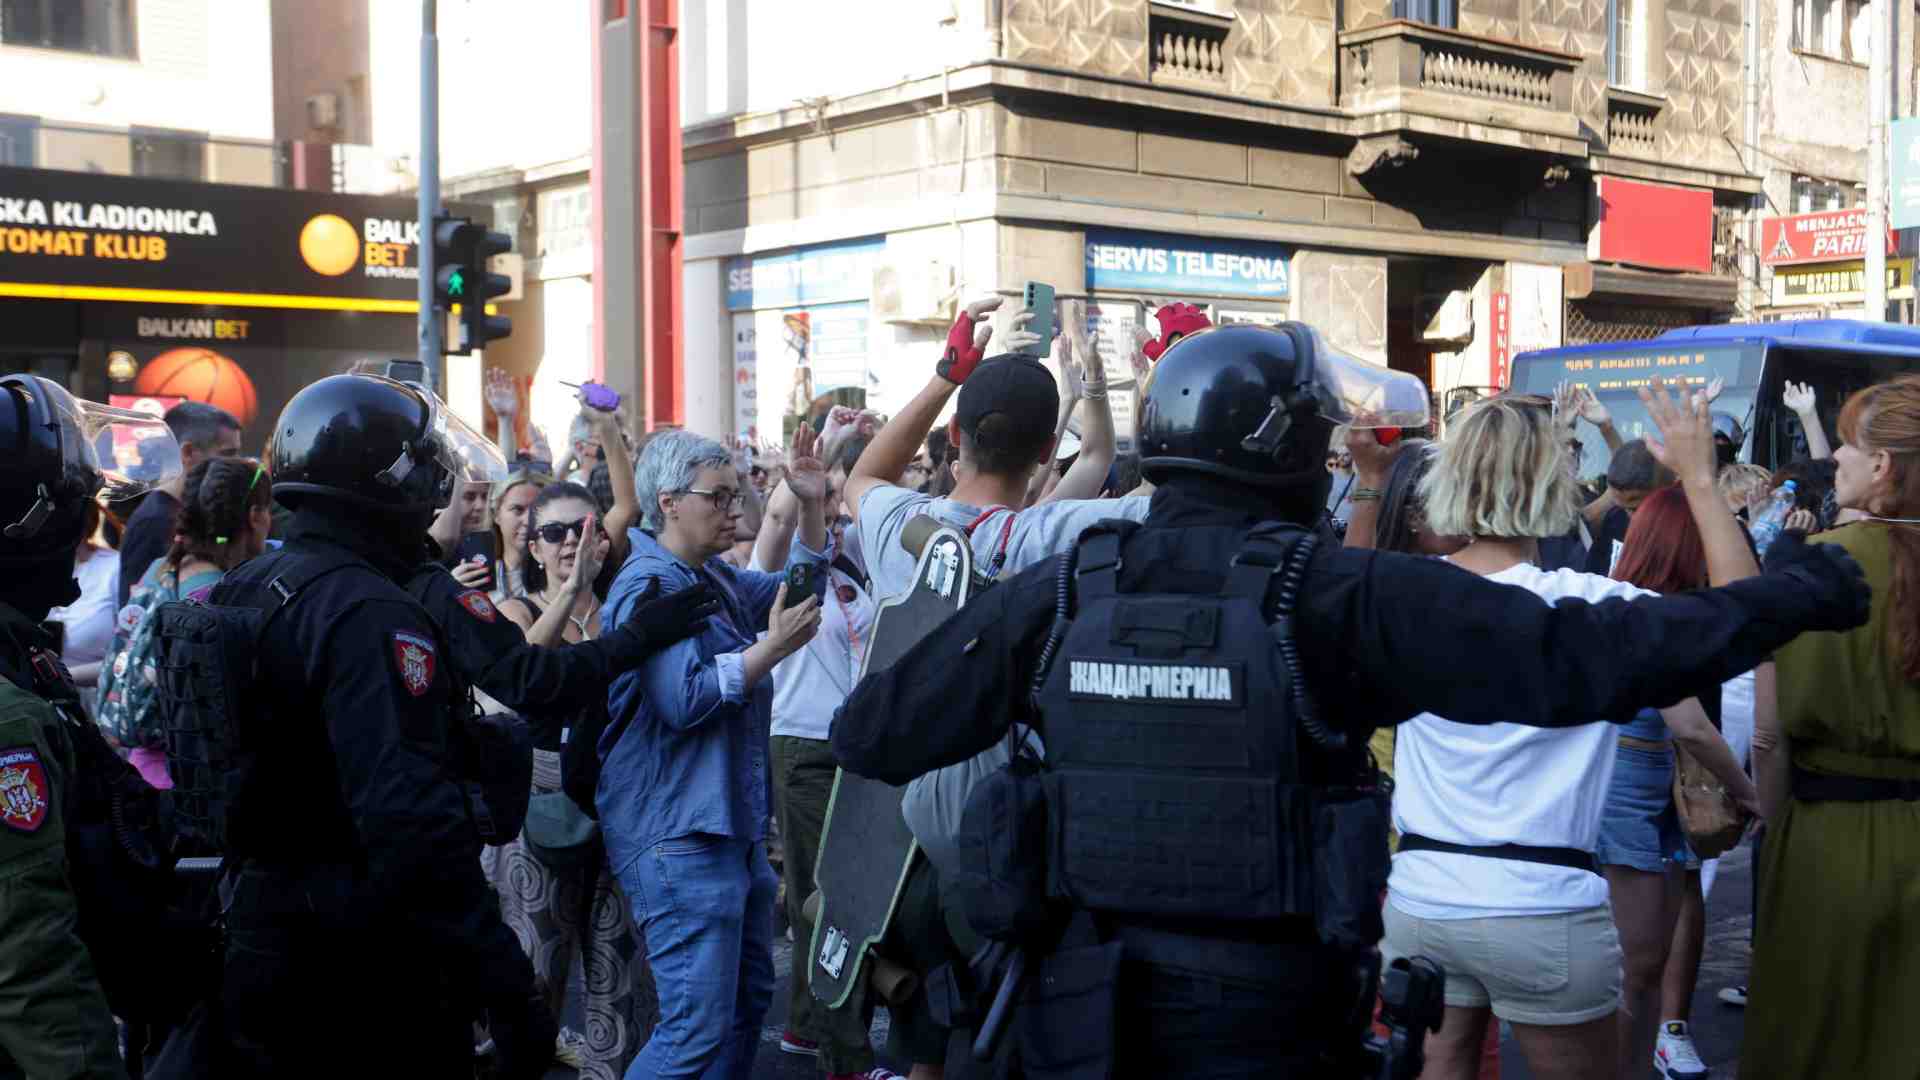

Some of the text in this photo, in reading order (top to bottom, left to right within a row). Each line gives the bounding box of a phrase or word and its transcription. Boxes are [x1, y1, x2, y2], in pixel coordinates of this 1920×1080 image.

[52, 200, 218, 236] KLADIONICA
[365, 217, 420, 245] BALK
[94, 232, 167, 261] KLUB
[365, 242, 408, 267] BET
[1086, 242, 1288, 281] SERVIS TELEFONA
[137, 317, 249, 339] BALKAN BET
[1070, 661, 1232, 700] ЖАНДАРМЕРИЈА
